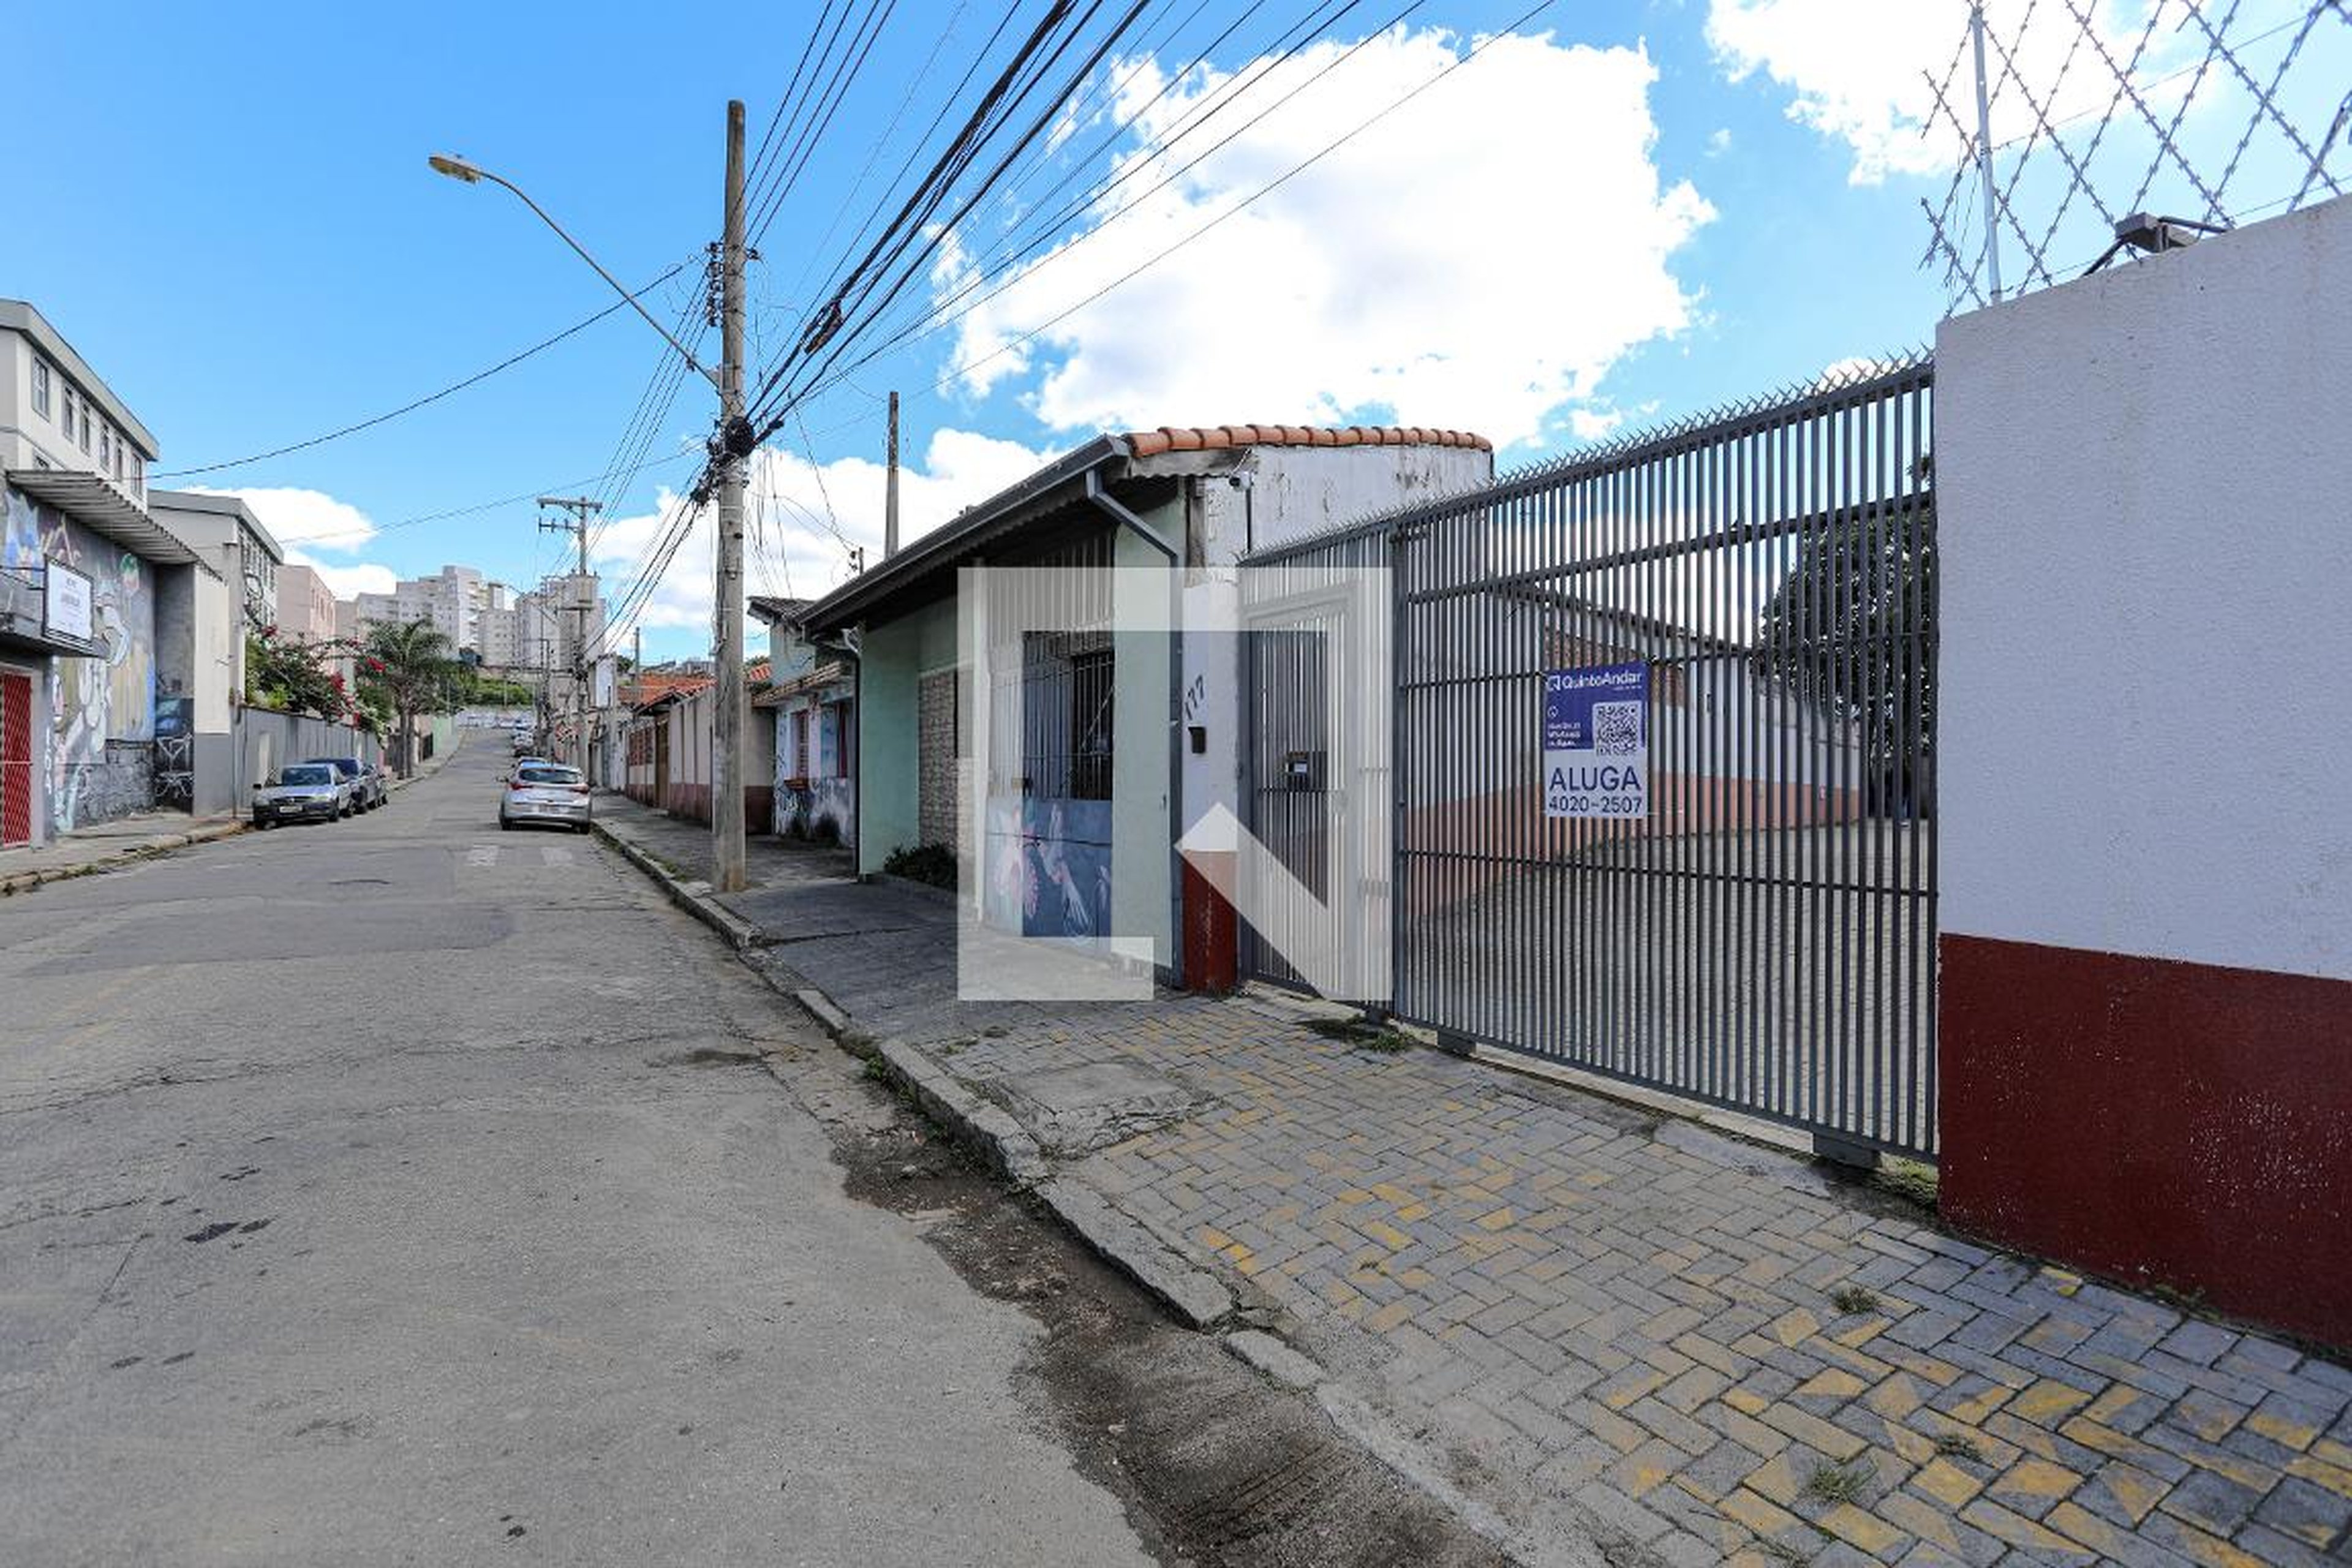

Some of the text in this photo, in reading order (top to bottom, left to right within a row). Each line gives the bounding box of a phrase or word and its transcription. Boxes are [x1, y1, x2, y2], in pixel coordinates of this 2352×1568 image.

[1185, 674, 1204, 721] 177
[1549, 766, 1642, 791] ALUGA
[1549, 796, 1642, 813] 4020-2507
